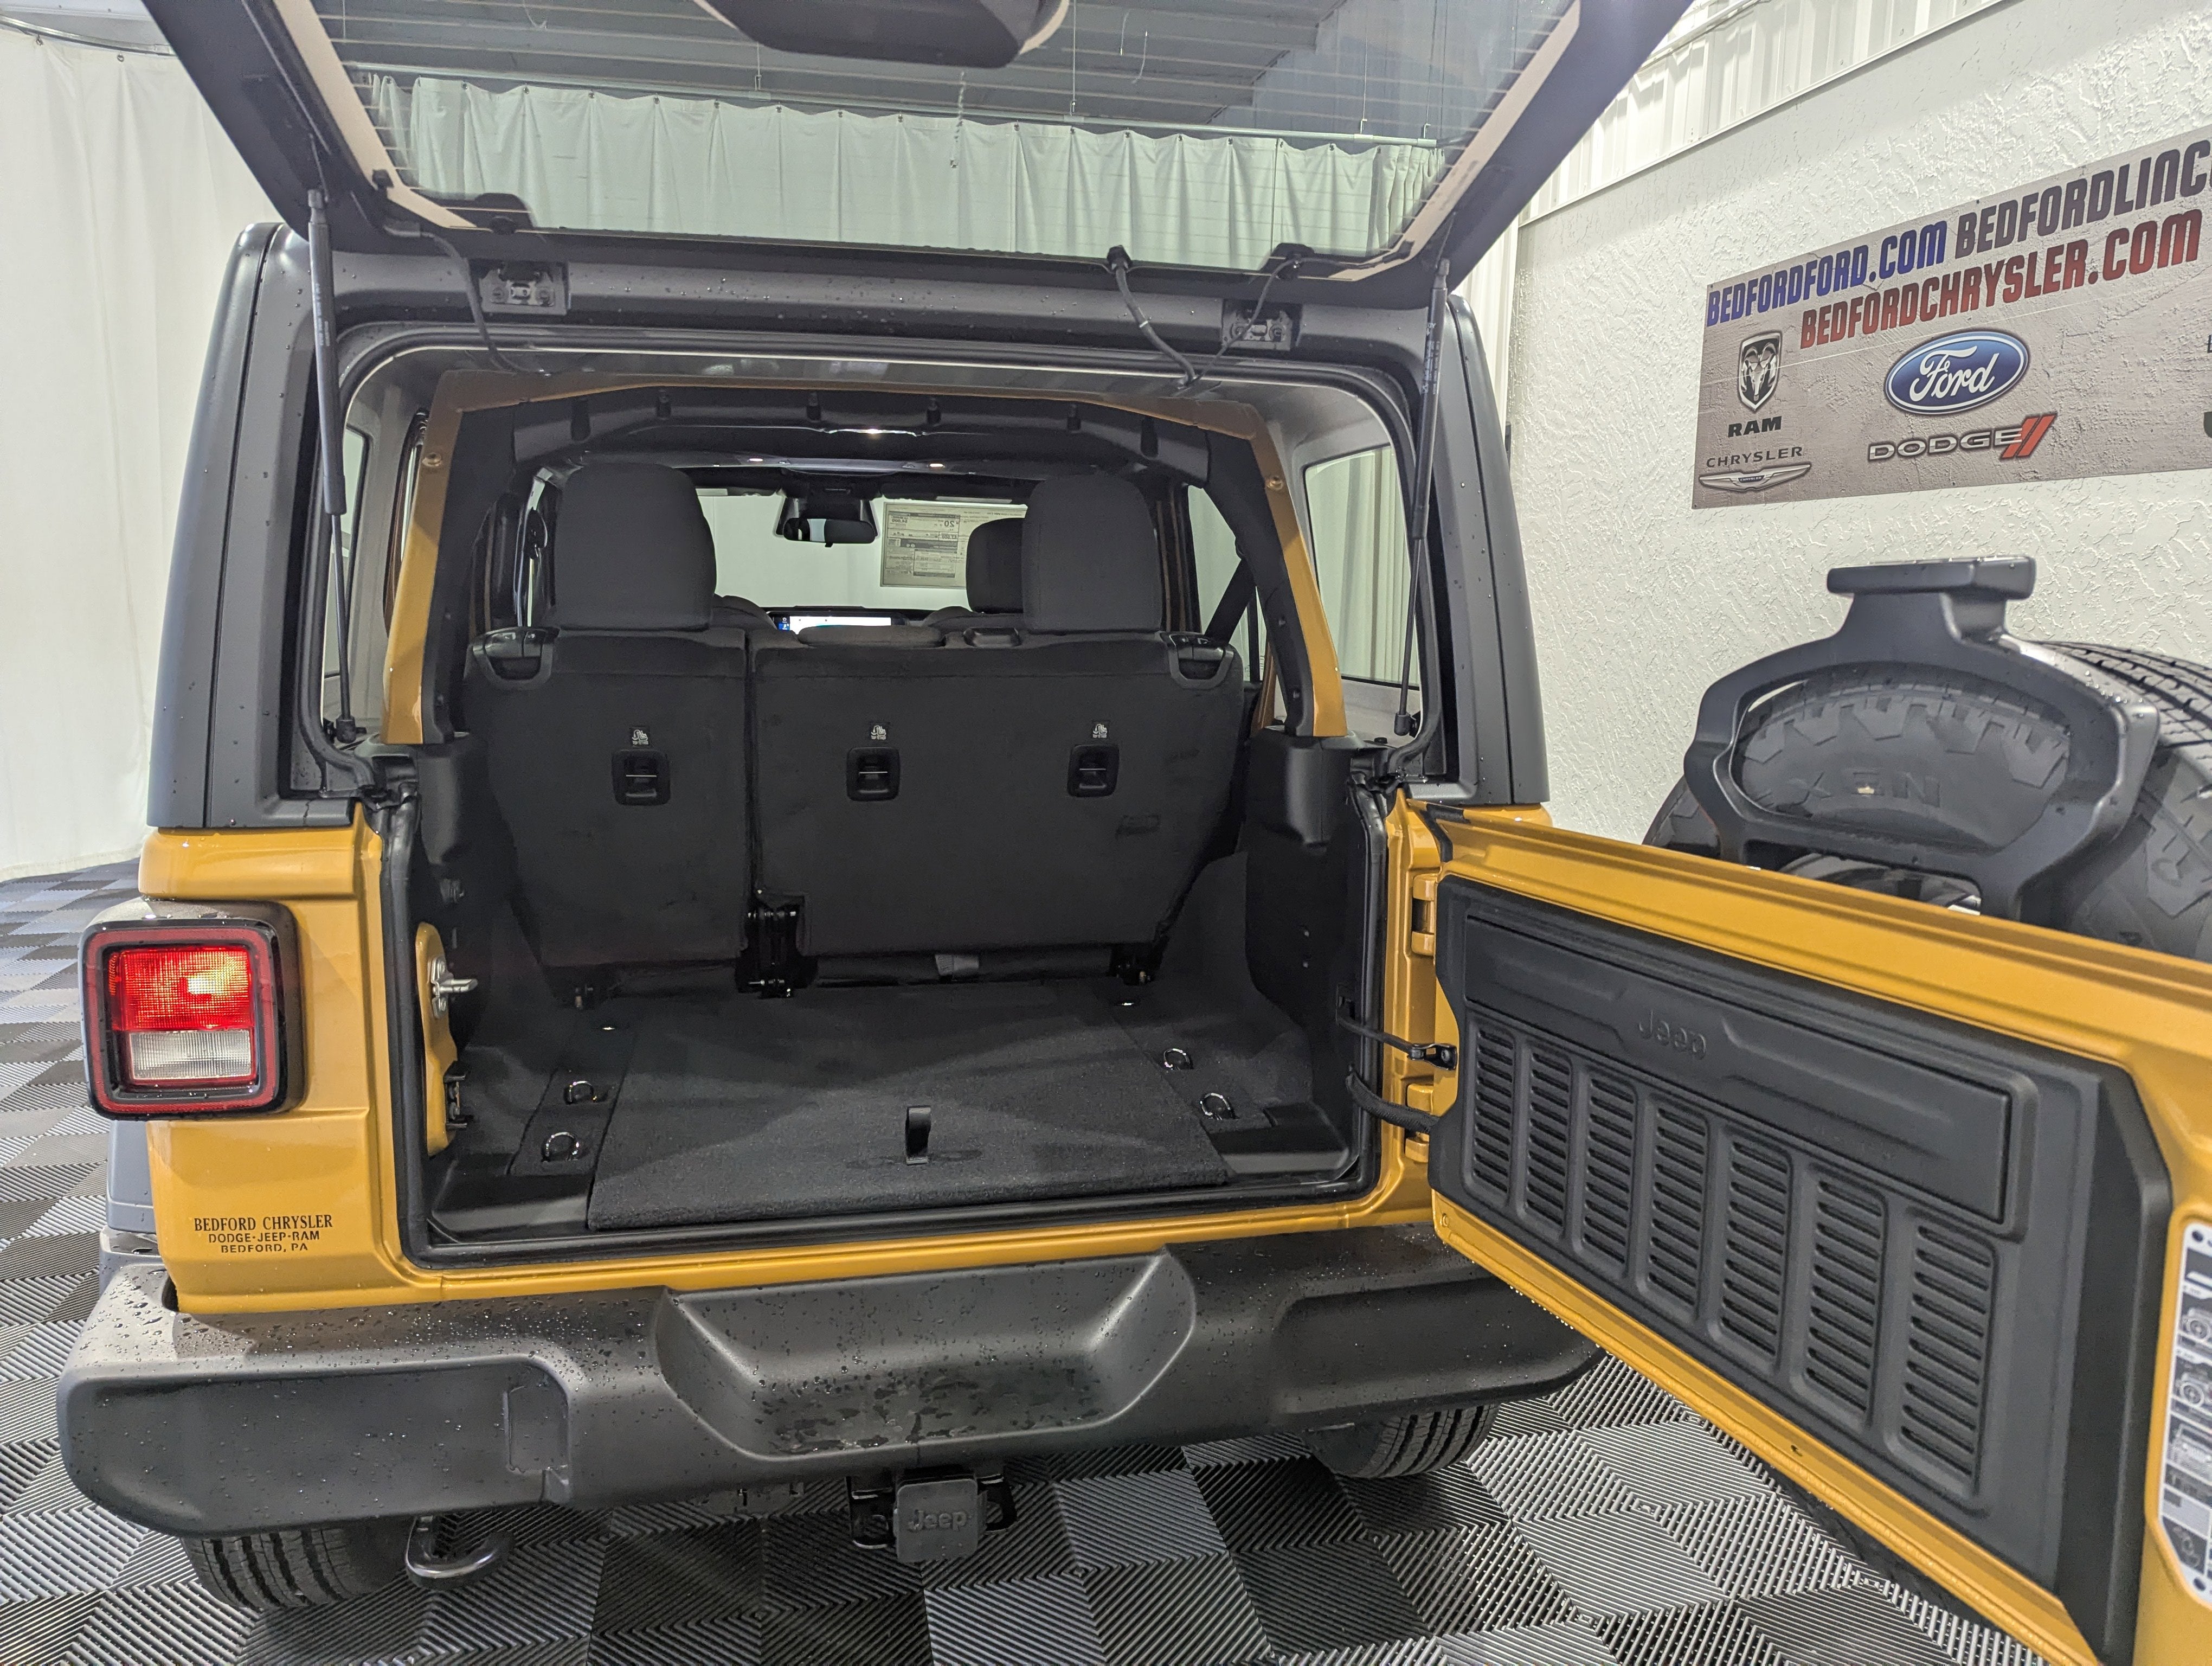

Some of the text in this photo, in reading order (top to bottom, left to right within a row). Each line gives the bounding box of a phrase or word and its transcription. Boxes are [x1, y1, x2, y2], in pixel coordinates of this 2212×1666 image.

[1707, 139, 2212, 326] BEDFORDFORD.COM BEDFORDLINC
[1800, 209, 2203, 349] BEDFORDCHRYSLER.COM
[1909, 345, 2000, 402] Ford
[1728, 416, 1782, 438] RAM
[1868, 427, 2023, 460] DODGE
[1706, 446, 1803, 468] CHRYSLER
[194, 1214, 332, 1231] BEDFORD CHRYSLER
[208, 1231, 320, 1243] DODGE-JEEP-RAM
[221, 1243, 308, 1253] BEDFORD, PA
[907, 1509, 968, 1532] Jeep
